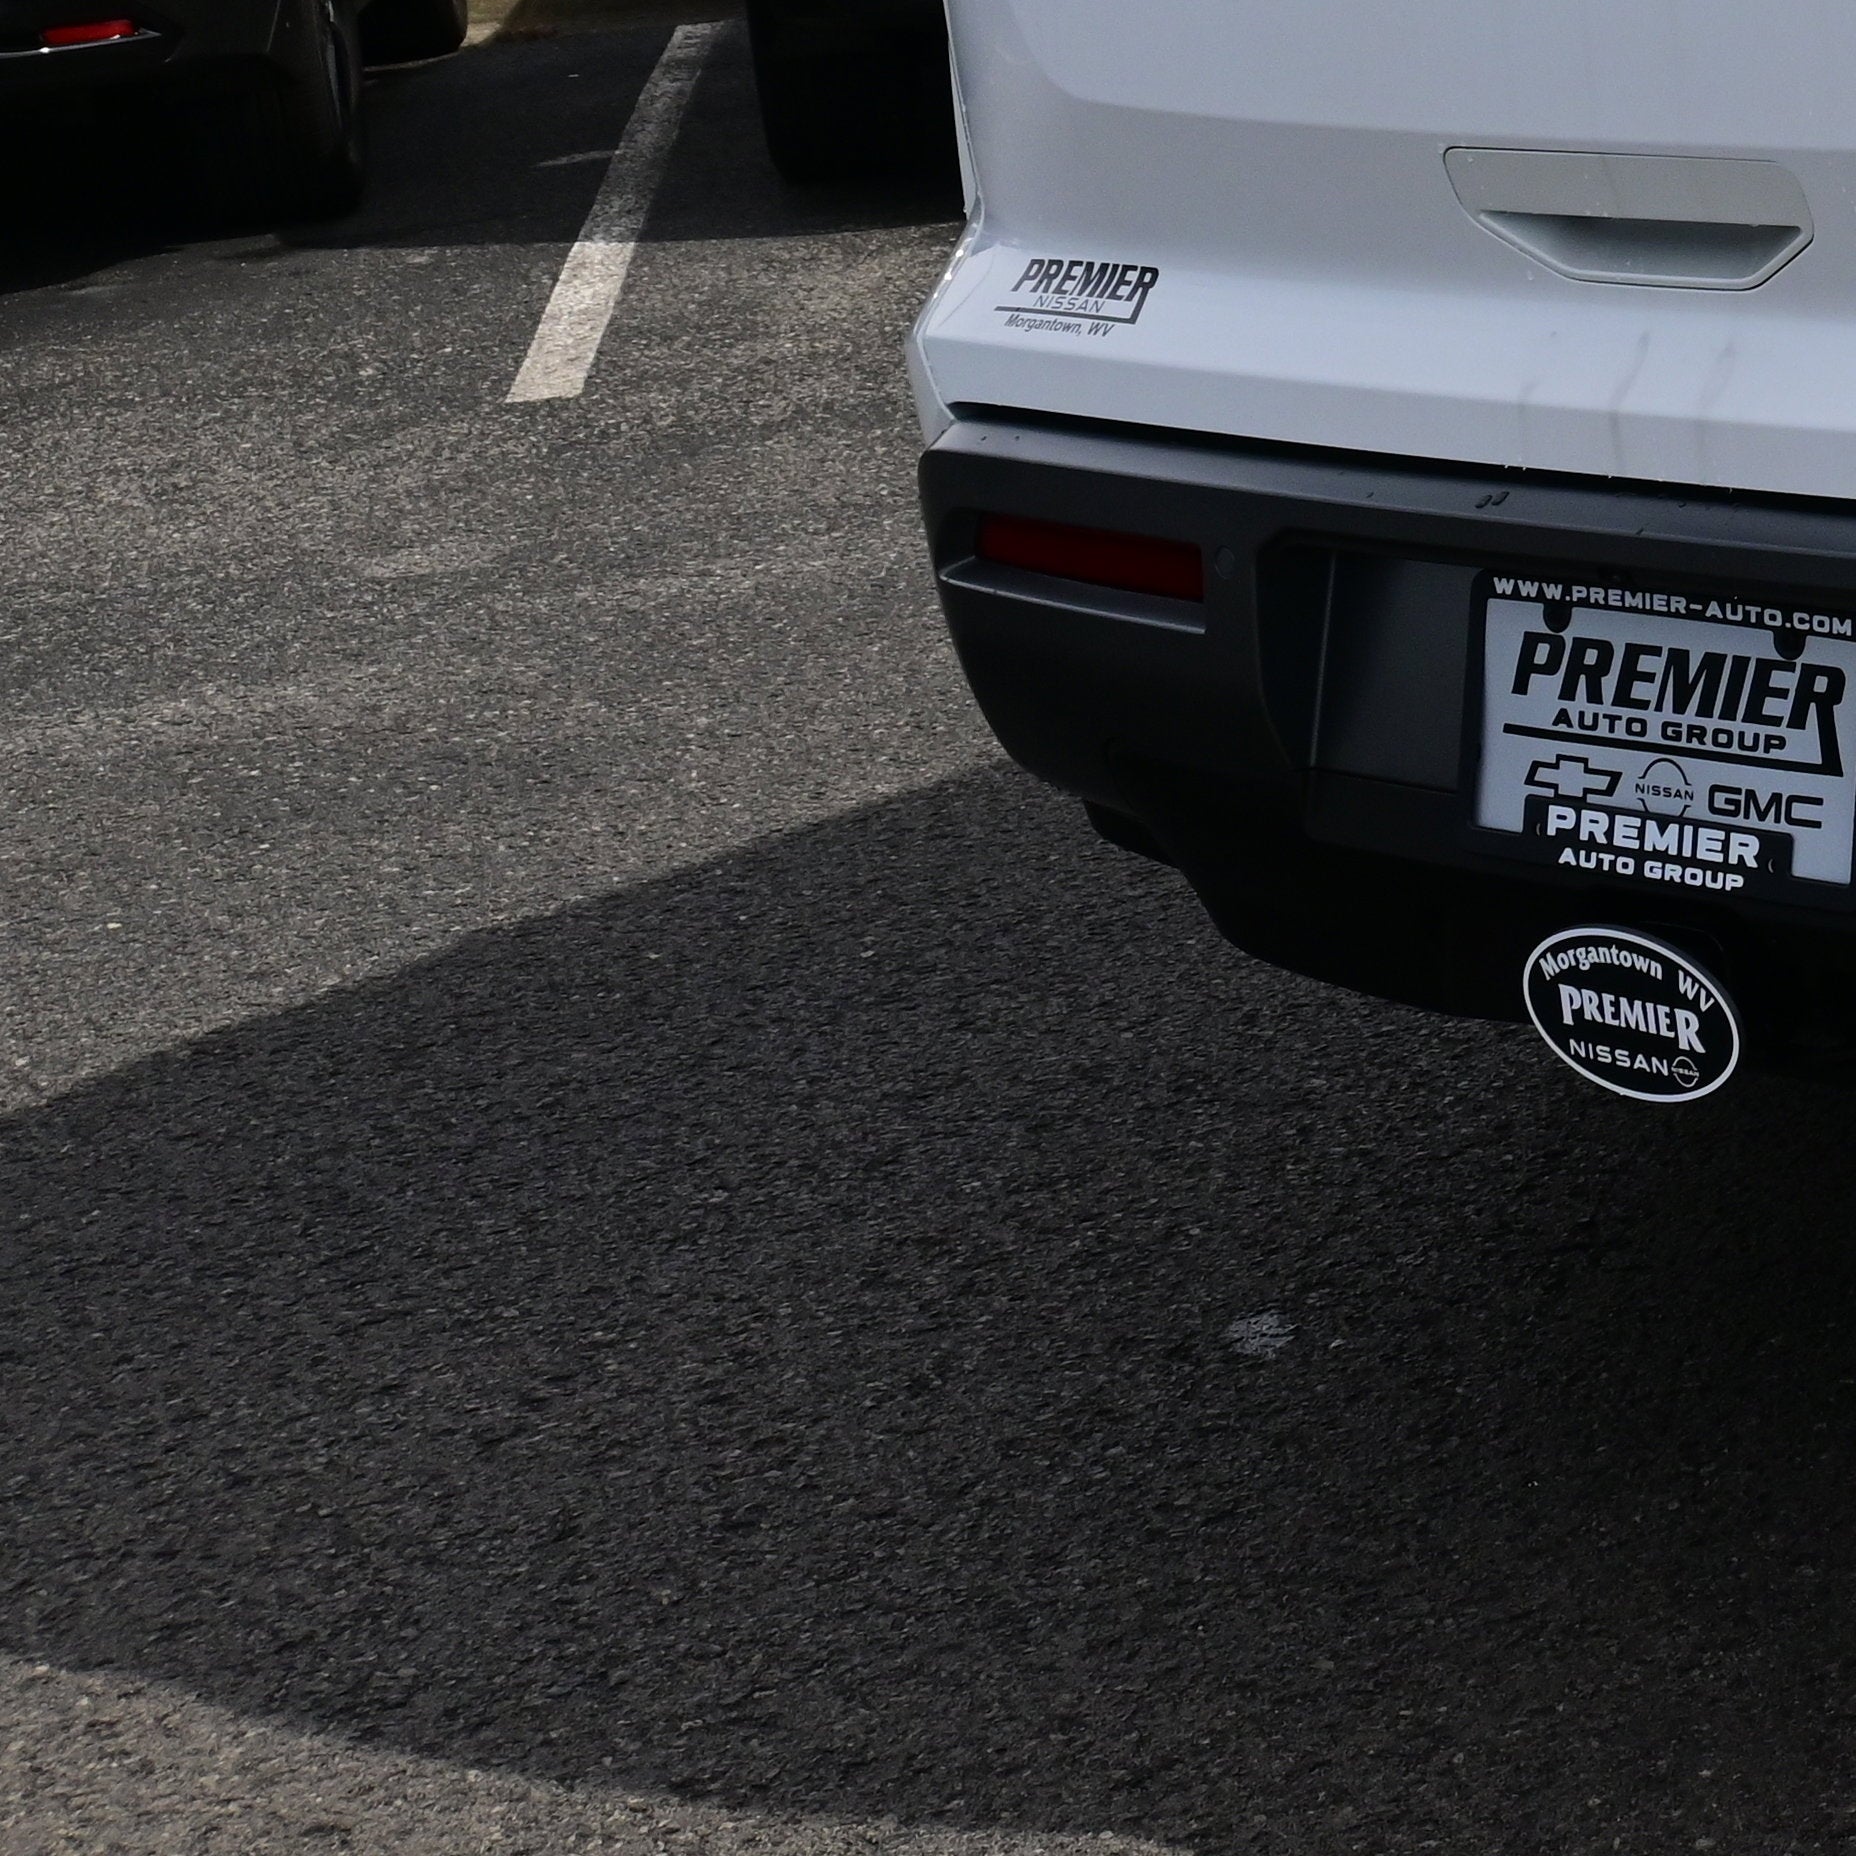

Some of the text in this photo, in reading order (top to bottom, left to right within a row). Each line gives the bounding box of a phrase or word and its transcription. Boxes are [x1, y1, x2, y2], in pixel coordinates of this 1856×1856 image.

[1011, 259, 1159, 302] PREMIER
[1004, 314, 1115, 337] Morgantown, WV
[1033, 295, 1105, 313] NISSAN
[1493, 577, 1853, 637] WWW.PREMIER-AUTO.COM
[1511, 630, 1847, 732] PREMIER
[1551, 708, 1788, 754] AUTO GROUP
[1634, 782, 1695, 802] NISSAN
[1707, 784, 1825, 829] GMC
[1546, 805, 1760, 869] PREMIER
[1558, 848, 1745, 892] AUTO GROUP
[1678, 969, 1715, 1013] WV
[1558, 983, 1706, 1054] PREMIER
[1569, 1038, 1669, 1077] NISSAN
